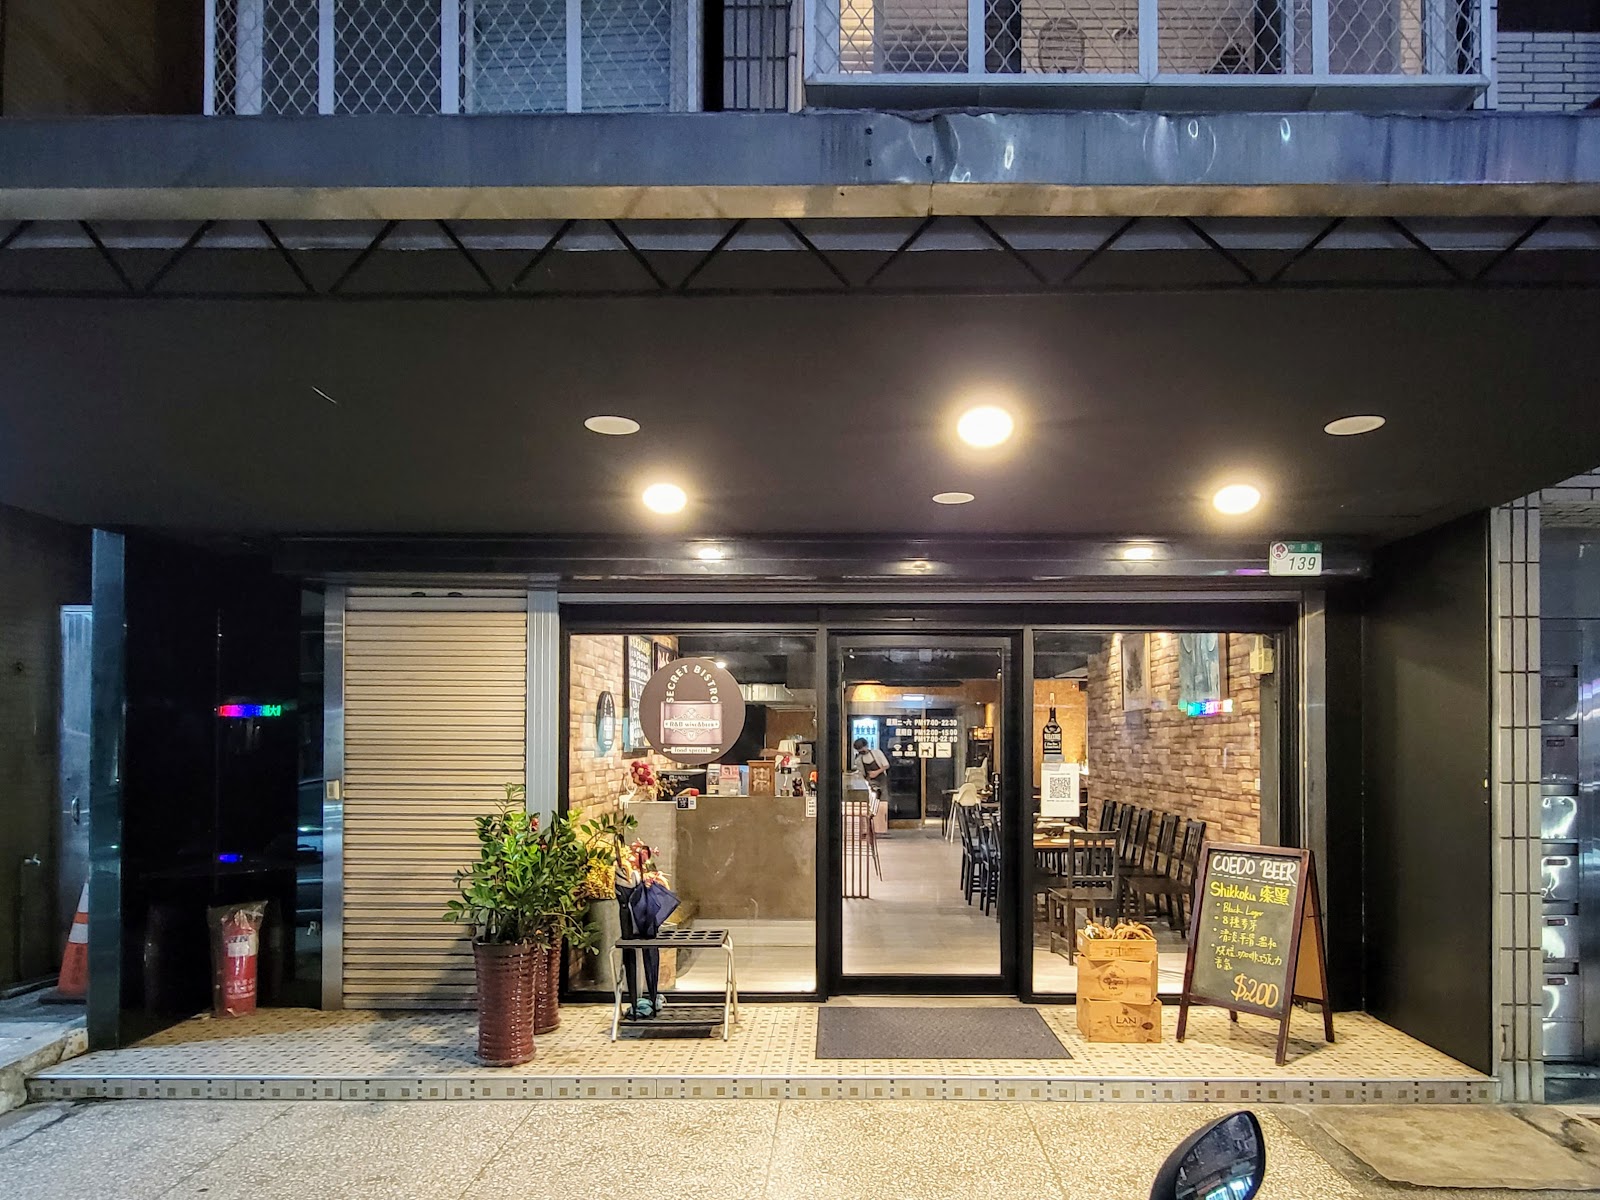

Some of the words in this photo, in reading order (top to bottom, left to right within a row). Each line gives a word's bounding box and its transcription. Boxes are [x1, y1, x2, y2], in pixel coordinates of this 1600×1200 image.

[1289, 556, 1316, 571] 139
[666, 664, 688, 703] SECRET
[693, 664, 719, 703] BISTRO
[1212, 855, 1256, 875] COEDO
[1259, 859, 1297, 884] BEER
[1209, 881, 1257, 902] Shikkoku
[1222, 901, 1244, 914] Black
[1230, 973, 1280, 1008] $200
[1115, 1015, 1137, 1024] LAN
